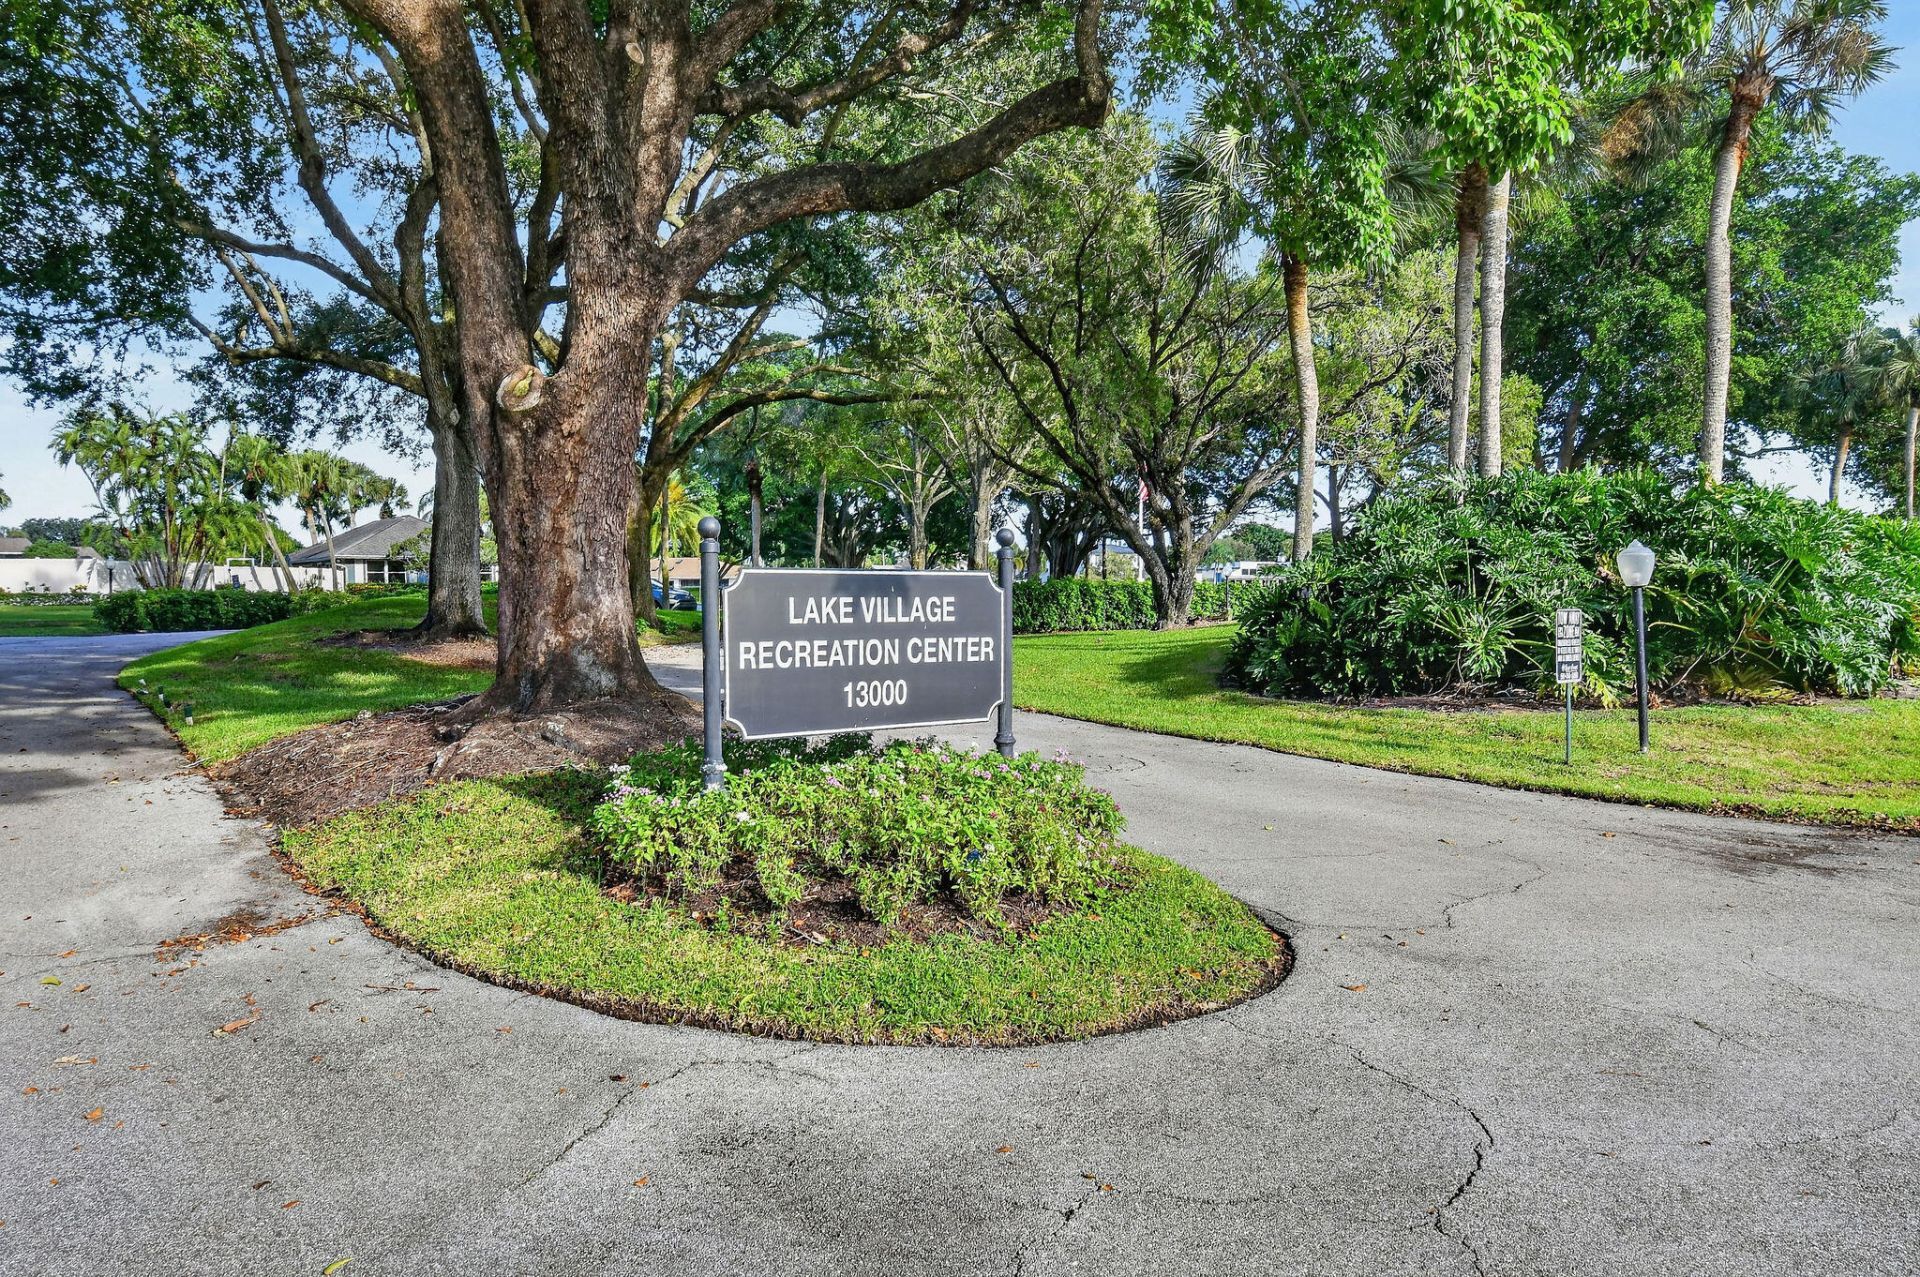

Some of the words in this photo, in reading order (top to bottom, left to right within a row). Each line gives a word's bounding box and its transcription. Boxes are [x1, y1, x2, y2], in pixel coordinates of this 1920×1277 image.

[789, 597, 853, 624] LAKE
[860, 597, 955, 623] VILLAGE
[739, 639, 899, 670] RECREATION
[907, 637, 994, 663] CENTER
[843, 680, 907, 707] 13000
